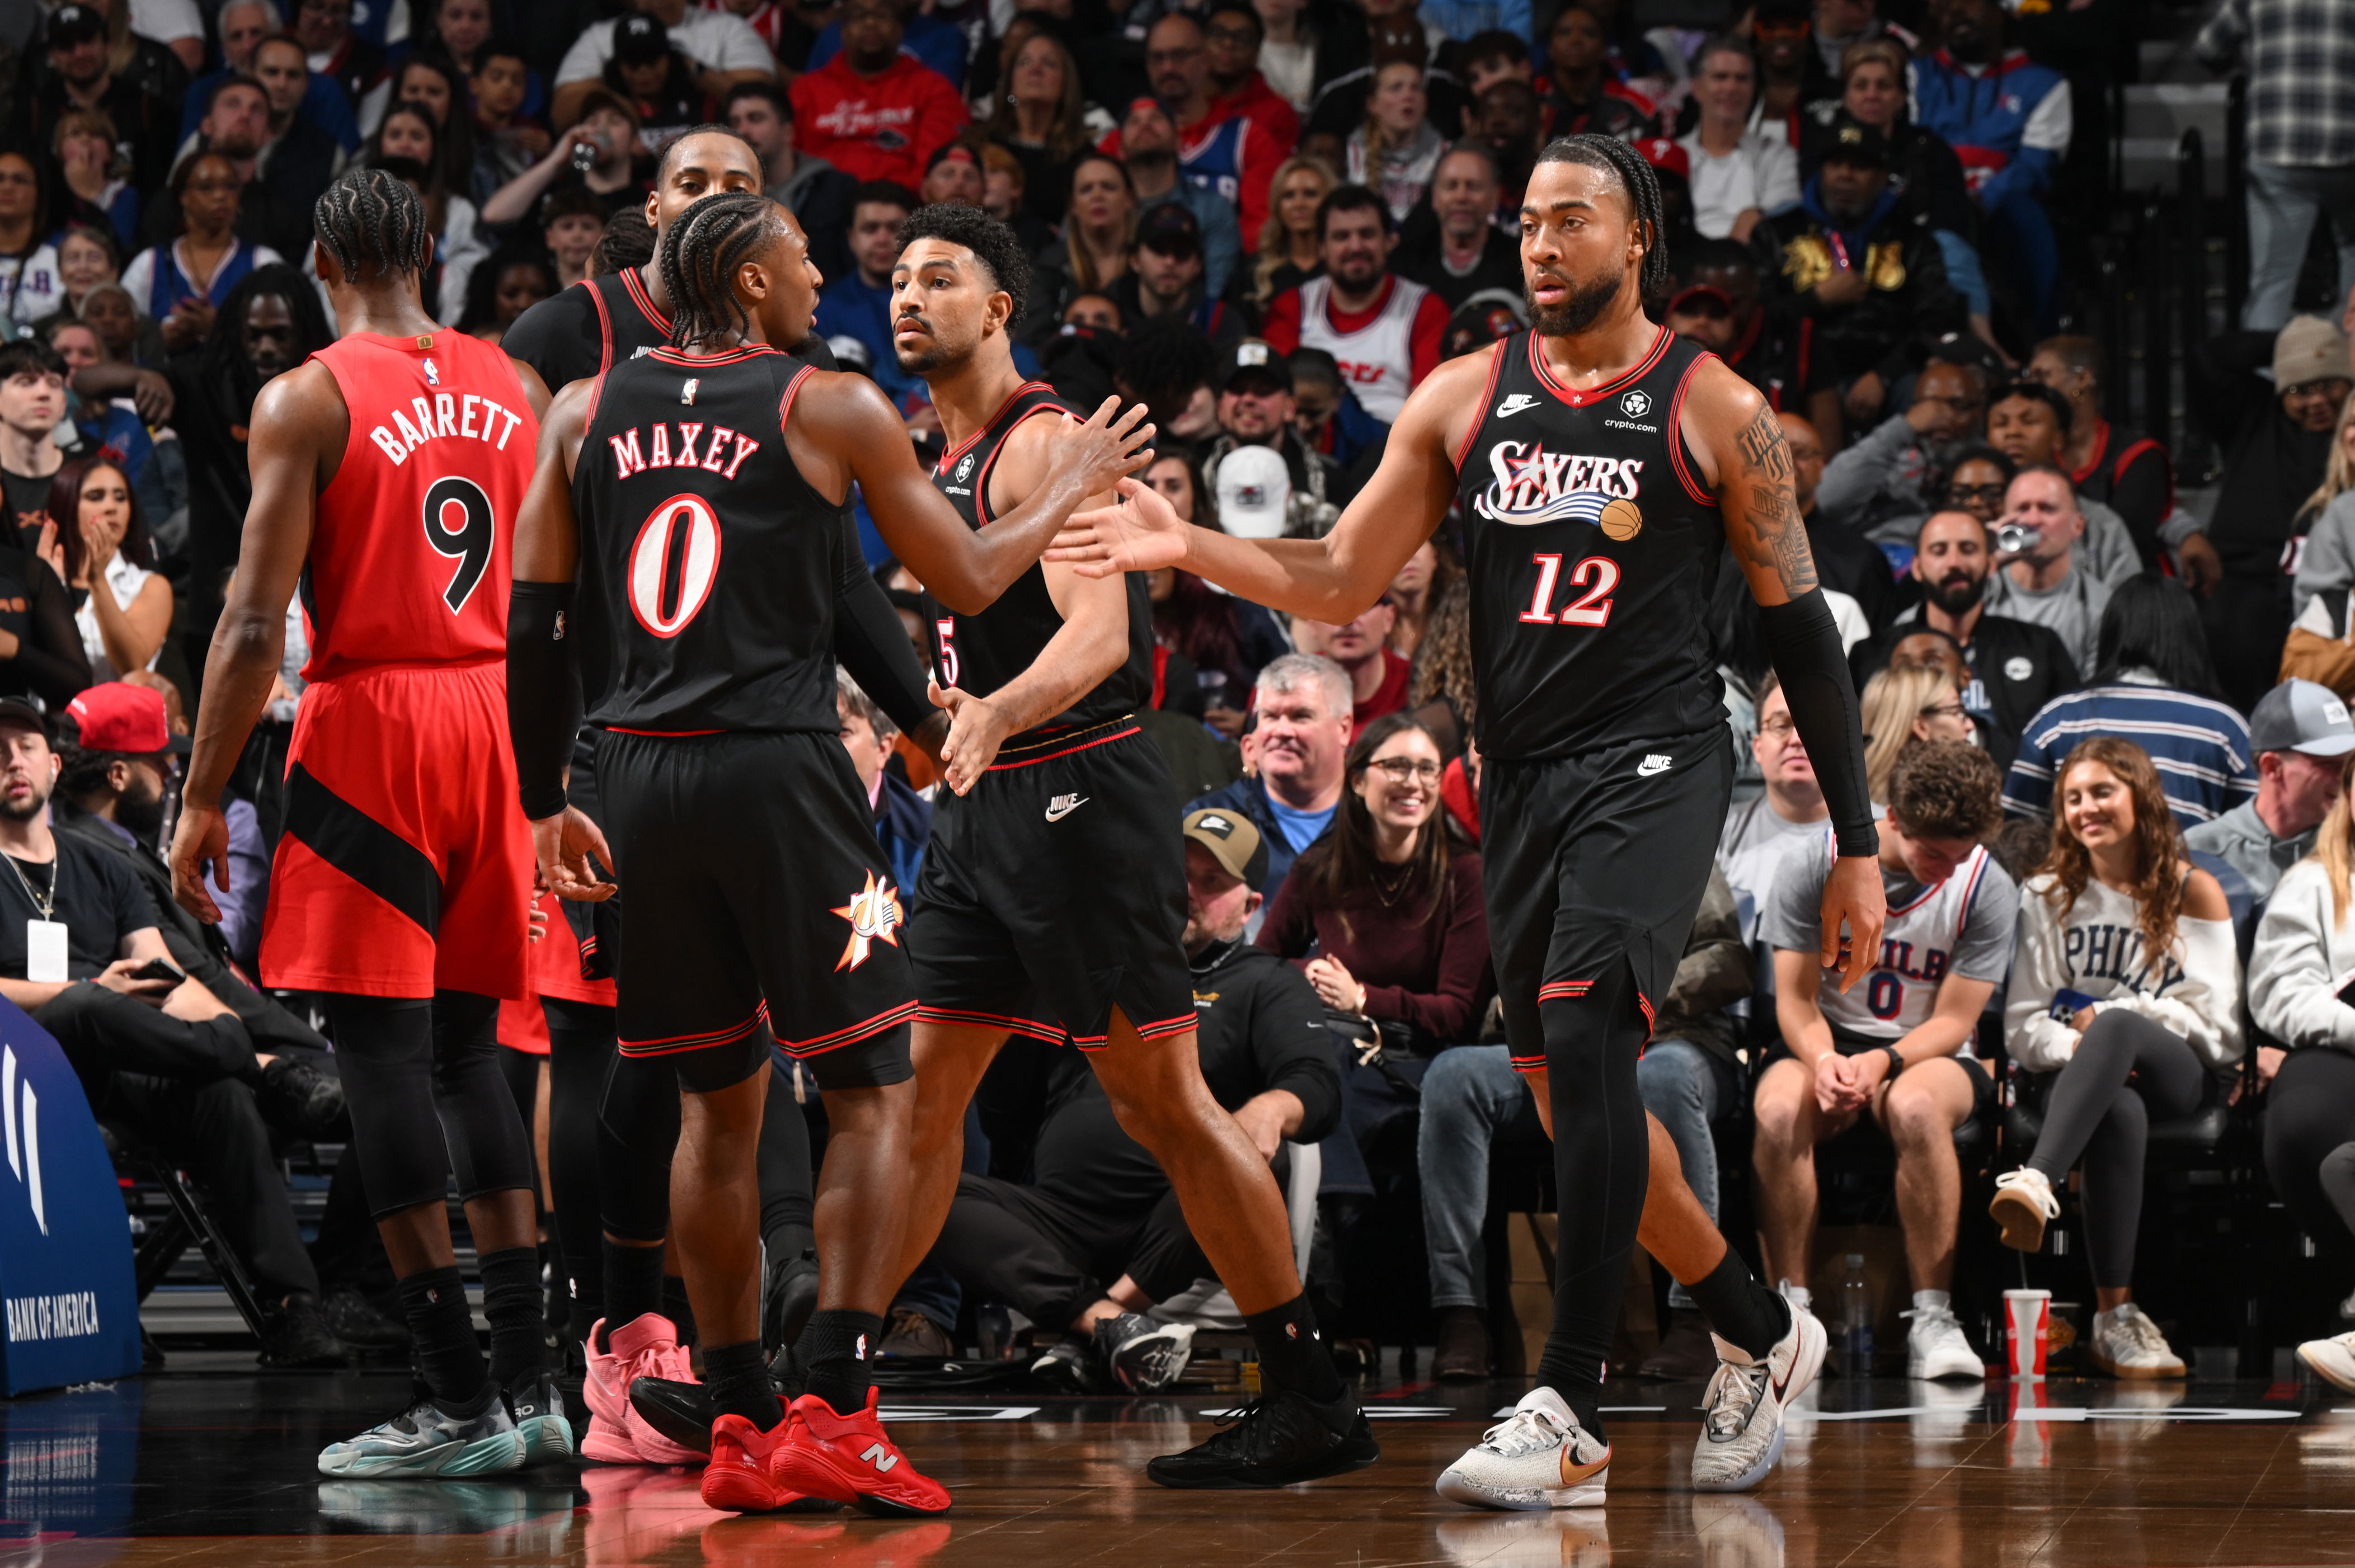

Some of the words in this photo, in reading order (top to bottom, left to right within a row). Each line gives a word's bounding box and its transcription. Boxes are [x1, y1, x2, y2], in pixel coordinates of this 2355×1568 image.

[634, 346, 655, 359] NI
[370, 393, 521, 466] BARRETT
[608, 422, 760, 481] MAXEY
[1605, 419, 1657, 434] crypto.com
[945, 486, 971, 496] crypto.com
[422, 475, 495, 616] 9
[627, 493, 722, 639] 0
[1519, 553, 1621, 627] 12
[937, 616, 959, 687] 5
[1050, 792, 1078, 812] NIKE
[1868, 971, 1903, 1020] 0
[6, 1297, 39, 1343] BANK
[38, 1295, 51, 1340] OF
[53, 1291, 99, 1339] AMERICA
[858, 1442, 899, 1473] N
